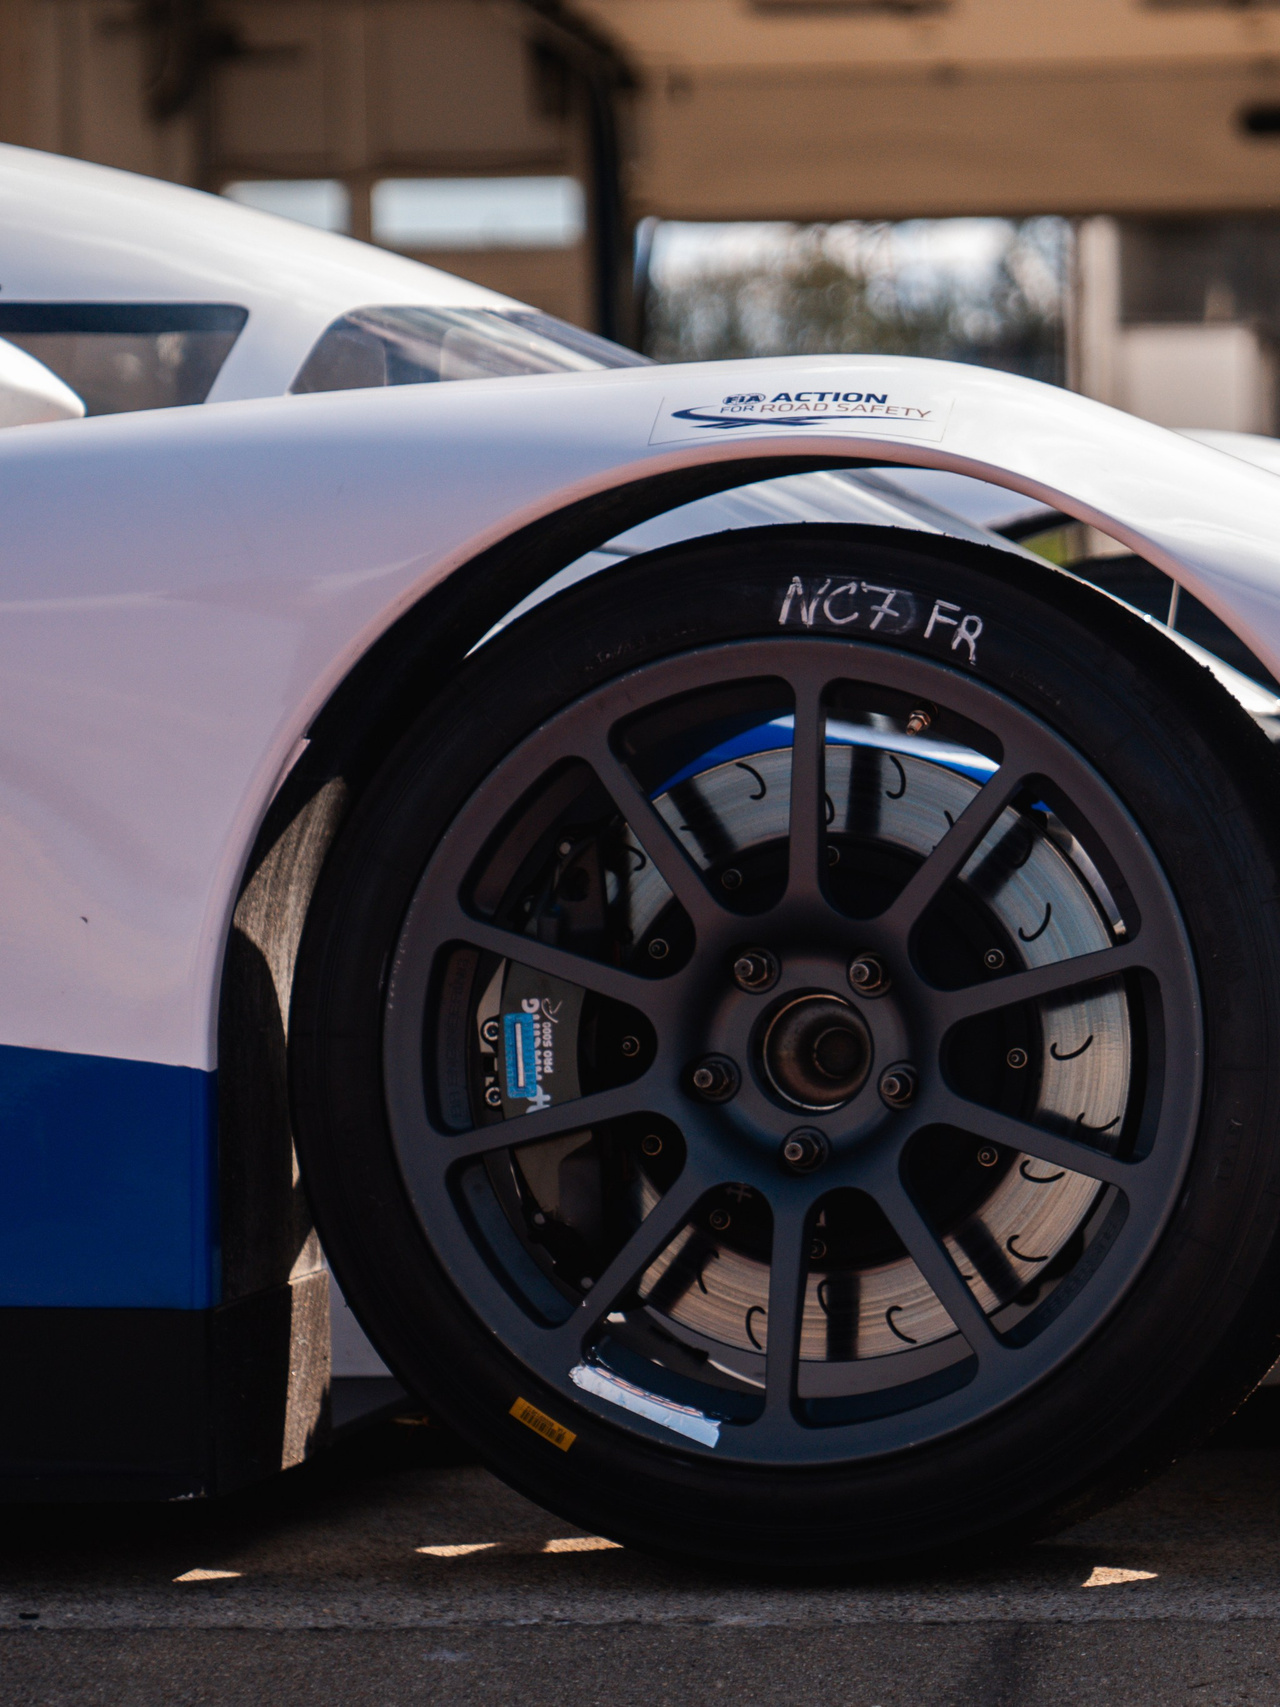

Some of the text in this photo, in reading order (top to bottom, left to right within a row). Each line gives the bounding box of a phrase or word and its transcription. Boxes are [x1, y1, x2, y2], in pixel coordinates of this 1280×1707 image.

[723, 392, 888, 405] FIA ACTION
[720, 403, 932, 418] FOR ROAD SAFETY
[923, 599, 983, 666] FR
[542, 1022, 553, 1048] 5000
[542, 1050, 554, 1073] PRO
